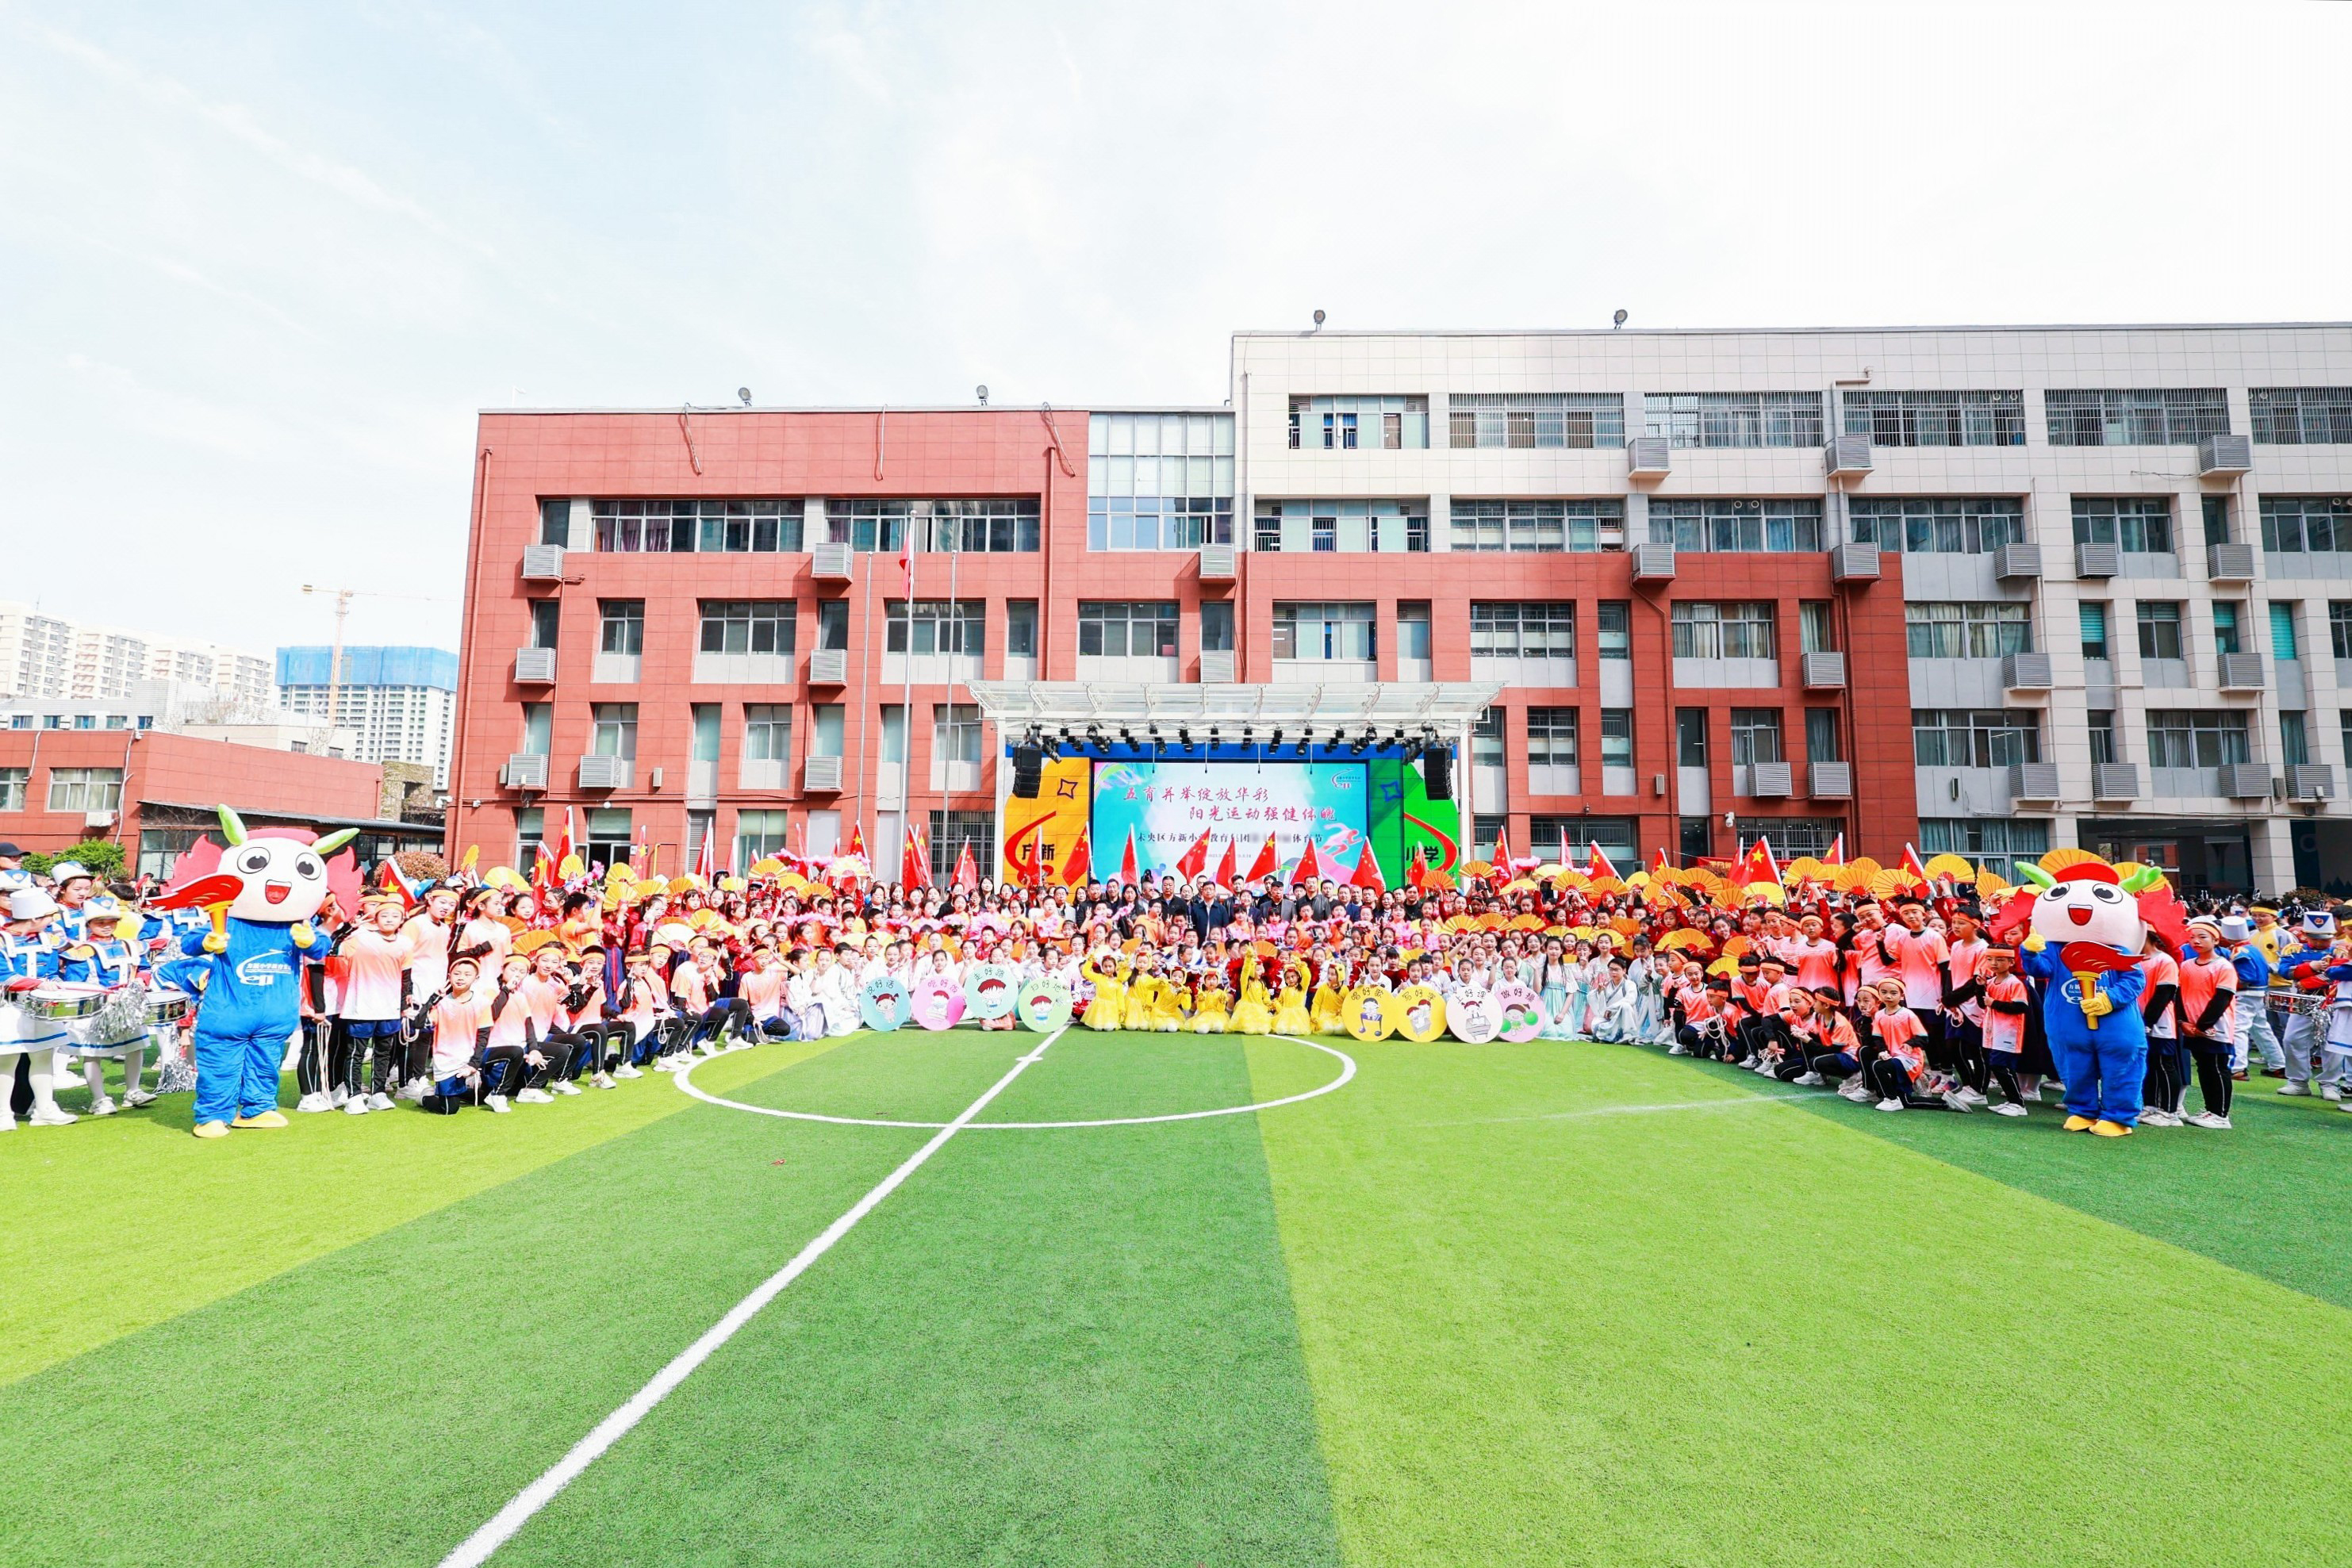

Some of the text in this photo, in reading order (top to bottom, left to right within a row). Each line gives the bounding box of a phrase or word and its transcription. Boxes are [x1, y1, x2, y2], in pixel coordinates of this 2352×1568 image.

[1123, 785, 1269, 803] 五育并举绽放华彩
[1189, 805, 1337, 822] 阳光运动强健体魄
[1406, 845, 1439, 863] 小学
